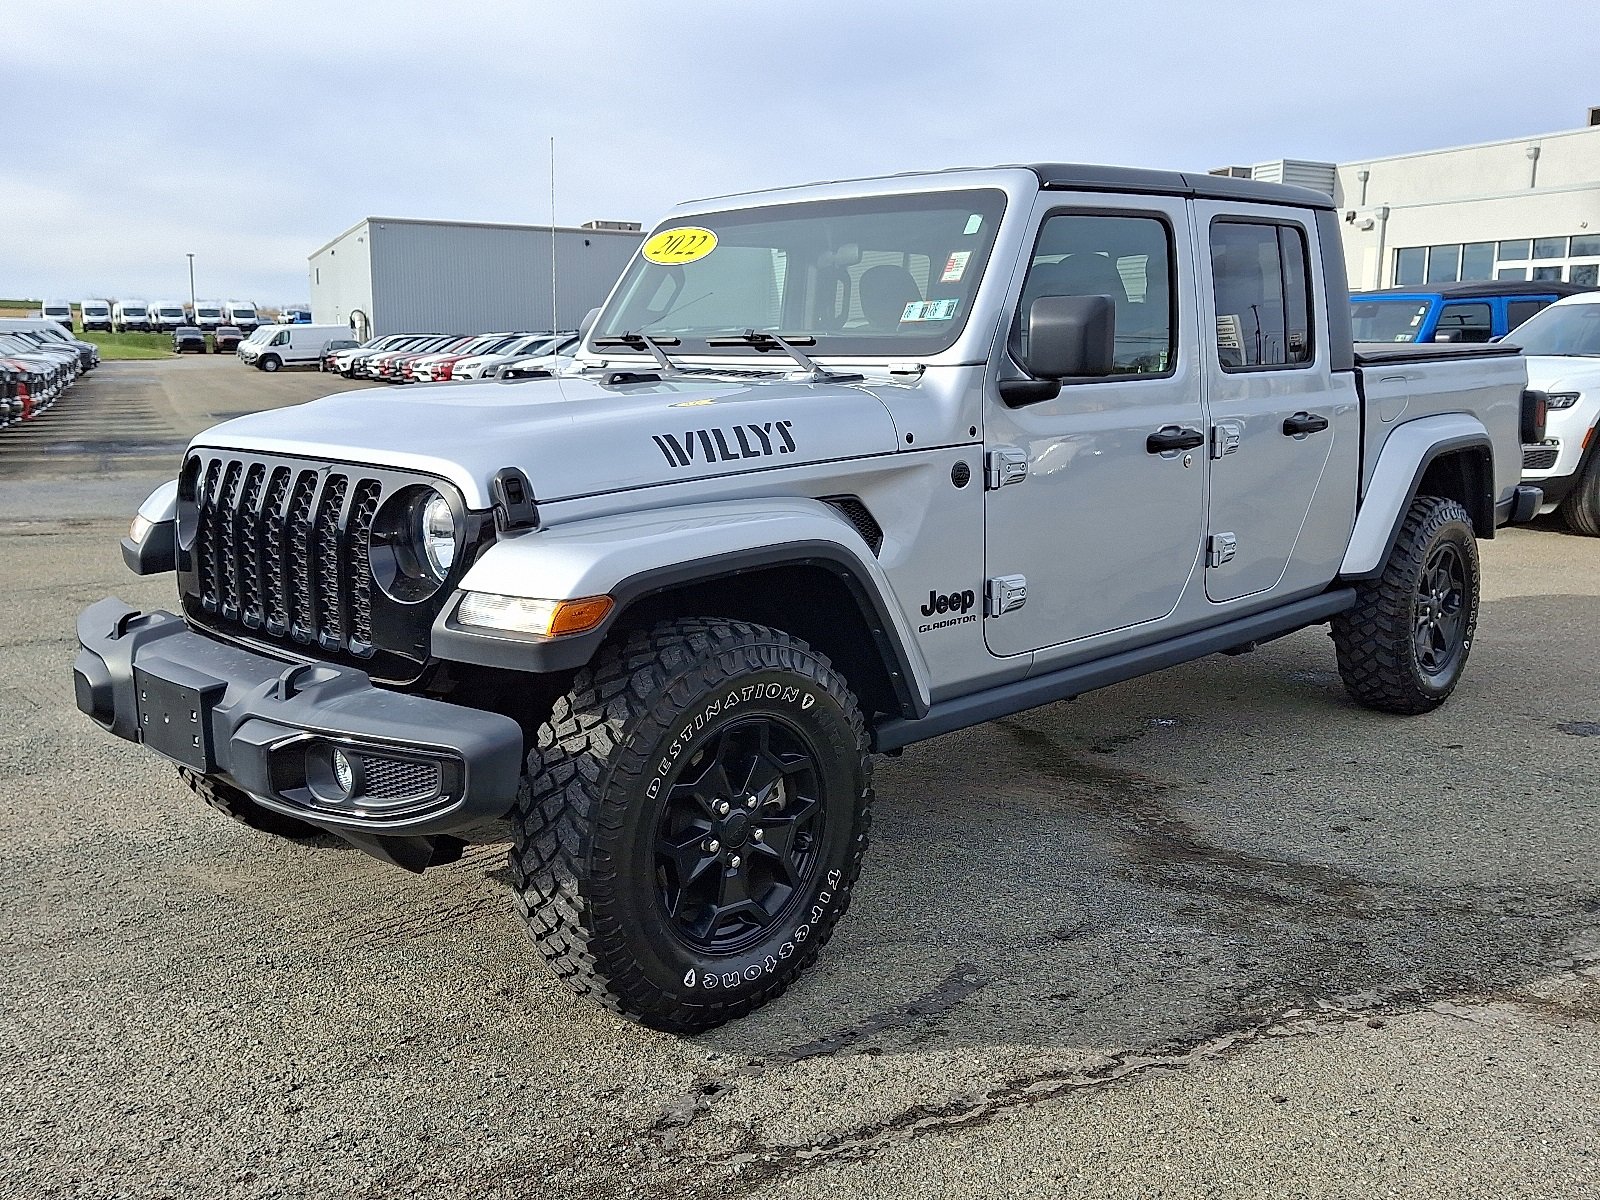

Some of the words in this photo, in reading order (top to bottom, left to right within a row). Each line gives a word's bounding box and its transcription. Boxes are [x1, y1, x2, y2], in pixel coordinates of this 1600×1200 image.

[652, 235, 707, 255] 2022
[652, 420, 796, 467] WILLYS
[920, 589, 975, 617] Jeep
[918, 614, 977, 633] GLADIATOR
[646, 683, 800, 799] DESTINATION
[702, 869, 842, 989] Firestone
